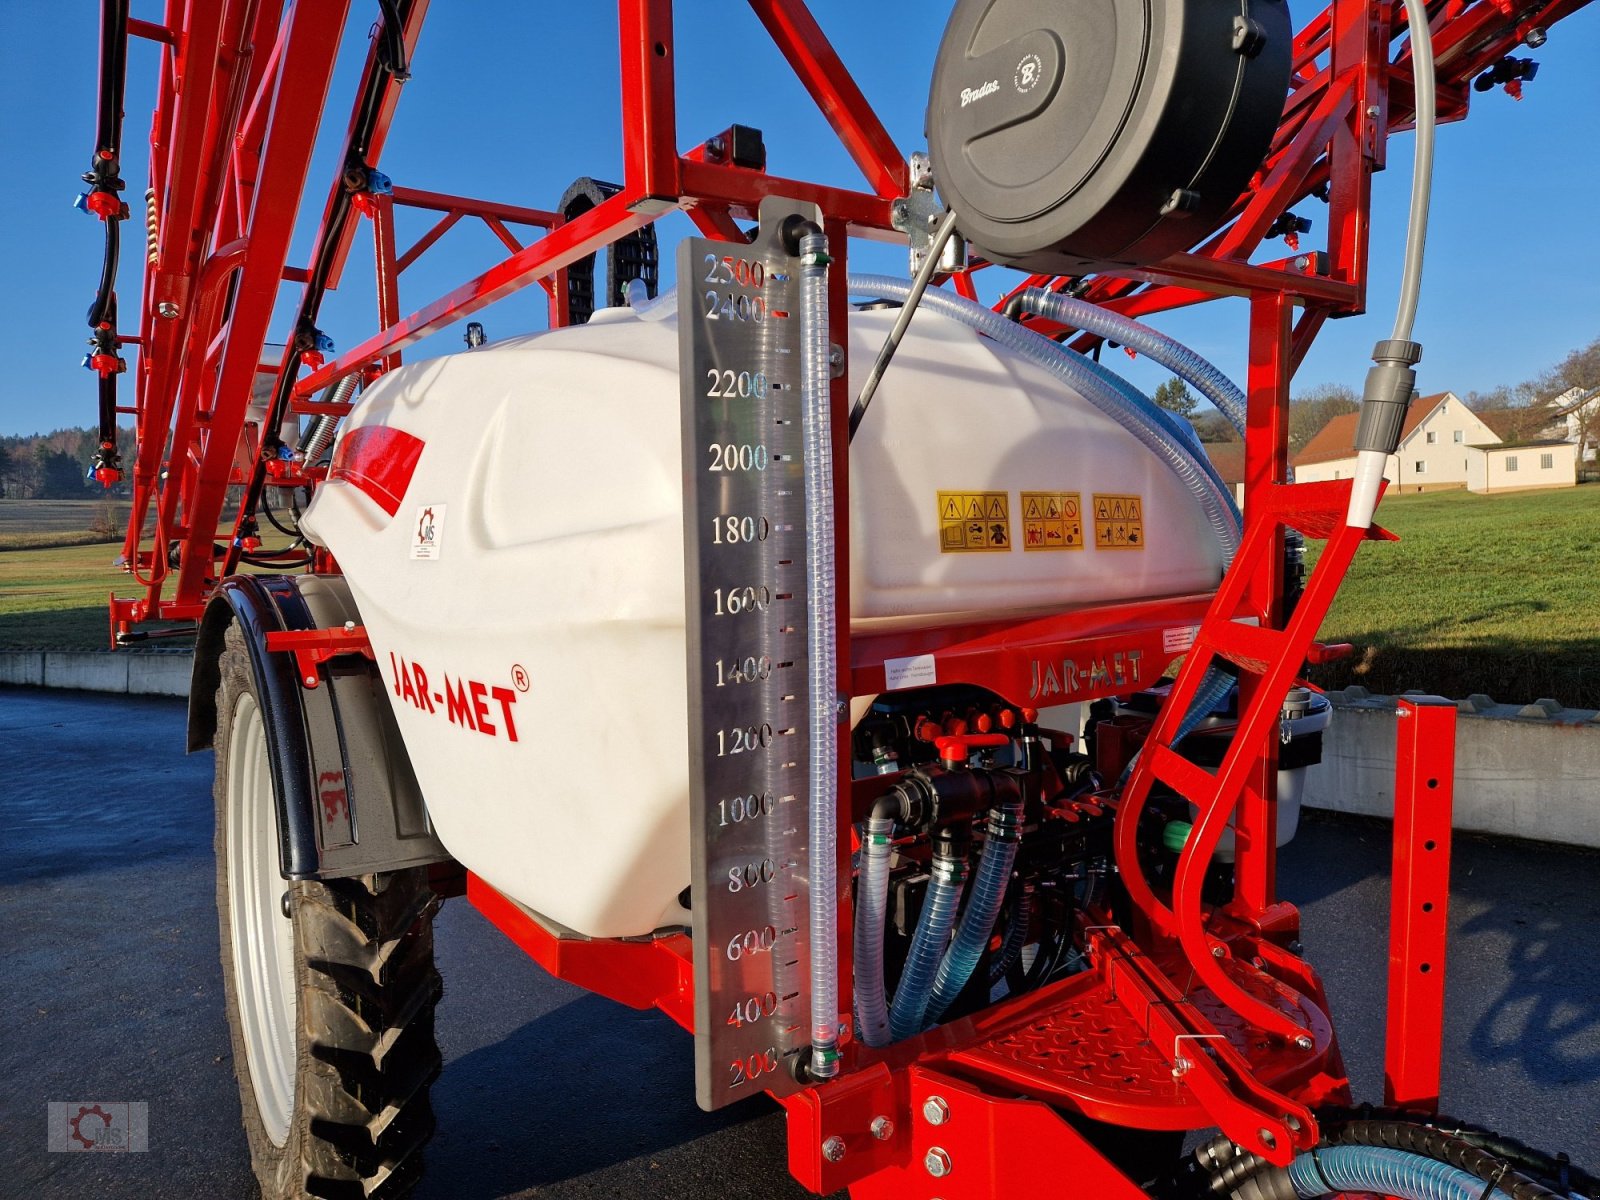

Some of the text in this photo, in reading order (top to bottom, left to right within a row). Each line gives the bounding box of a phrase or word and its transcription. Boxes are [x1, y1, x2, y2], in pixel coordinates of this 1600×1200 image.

[704, 253, 765, 289] 2500
[705, 290, 766, 324] 2400
[706, 368, 767, 399] 2200
[708, 443, 768, 471] 2000
[712, 516, 769, 544] 1800
[714, 586, 770, 616] 1600
[715, 655, 772, 687] 1400
[1029, 650, 1142, 699] JAR-MET
[717, 723, 773, 757] 1200
[718, 791, 774, 827] 1000
[728, 858, 776, 893] 800
[727, 925, 776, 962] 600
[727, 992, 778, 1028] 400
[729, 1046, 778, 1089] 200
